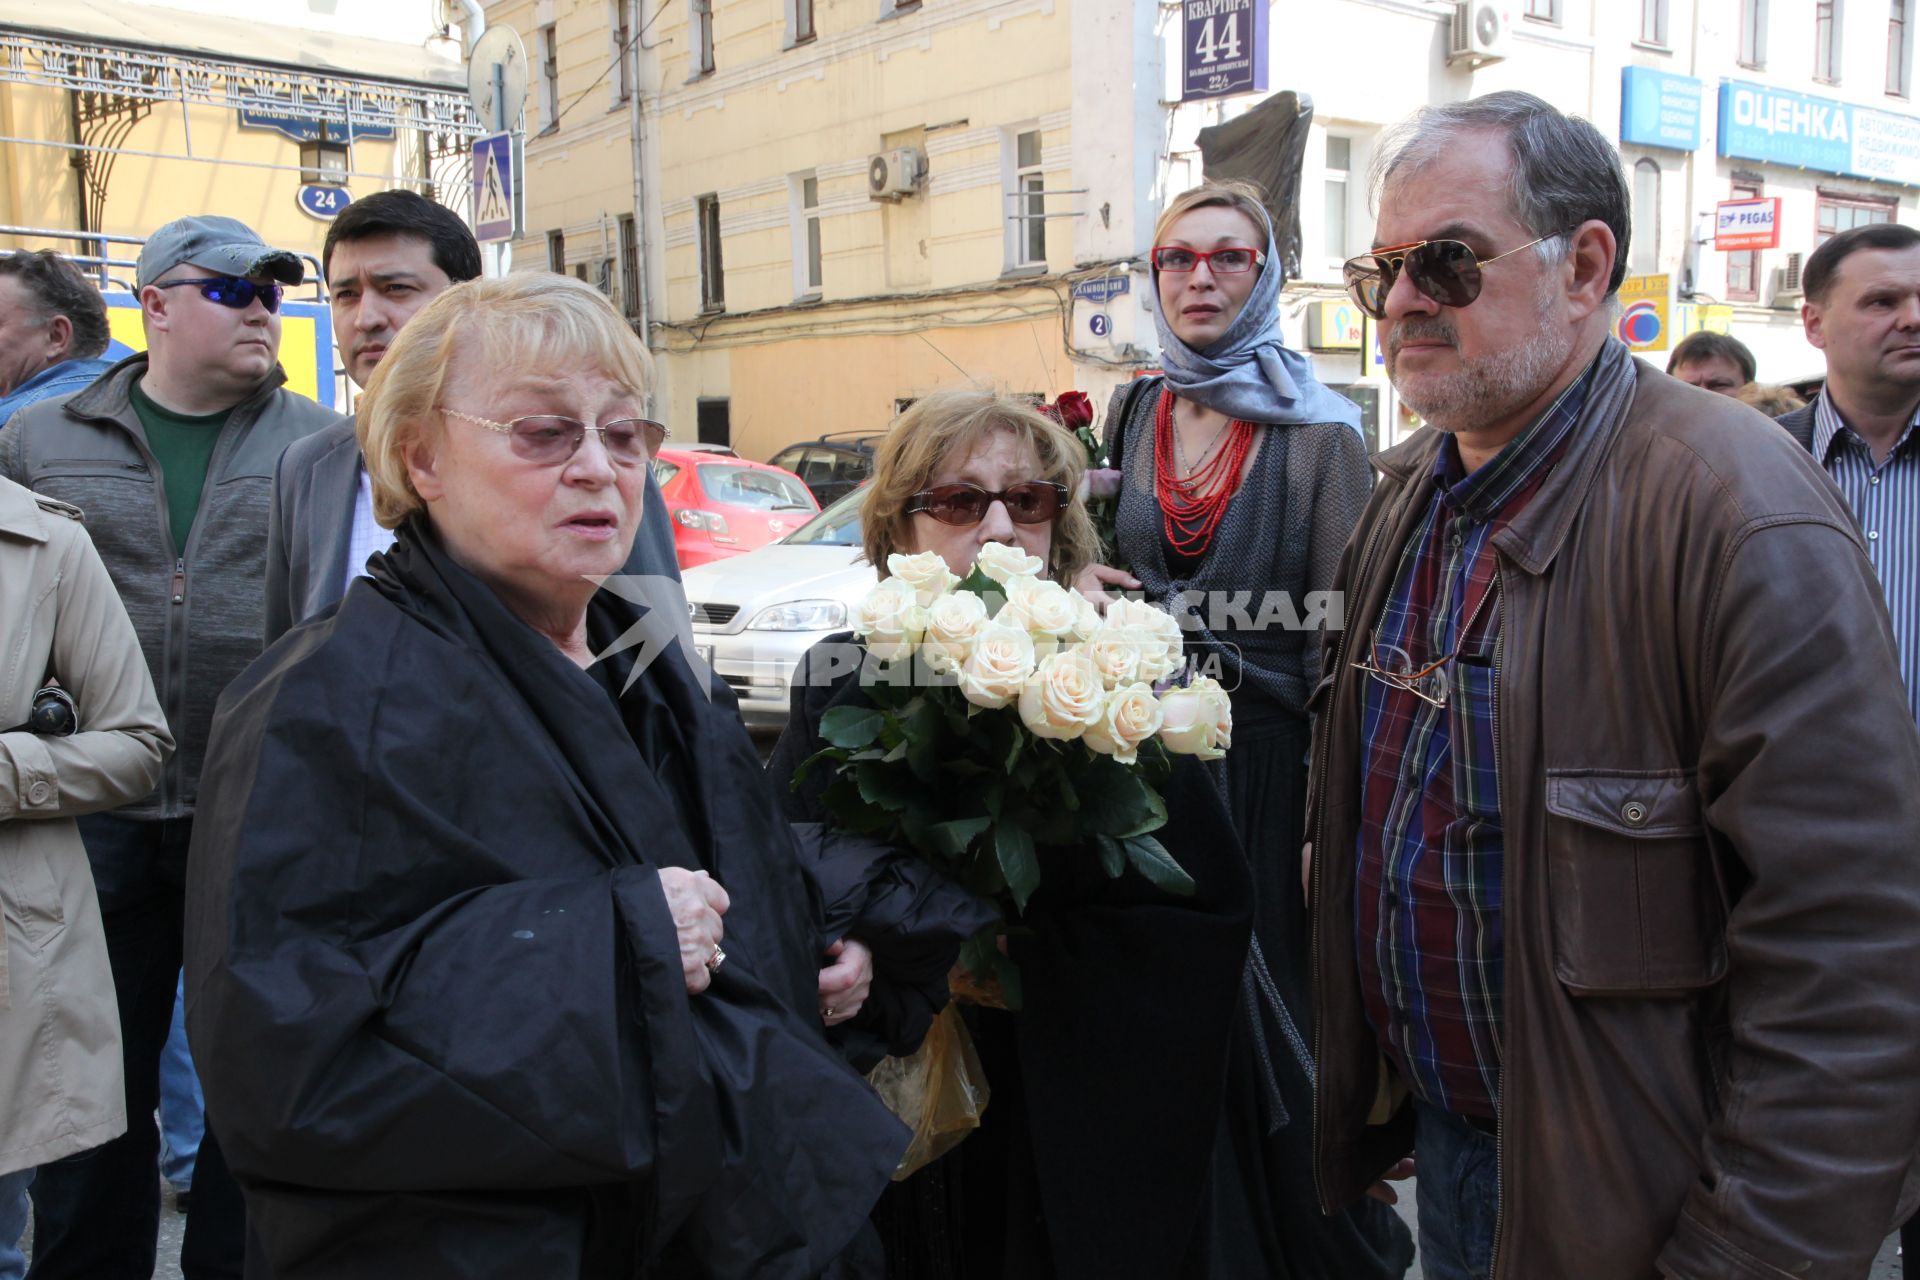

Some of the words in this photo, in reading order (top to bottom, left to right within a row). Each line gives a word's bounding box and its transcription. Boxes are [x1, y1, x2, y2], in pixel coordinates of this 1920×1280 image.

[1188, 0, 1249, 20] КВАРТИРА
[1195, 13, 1241, 64] 44
[1734, 89, 1849, 144] ОЦЕНКА
[315, 190, 336, 208] 24
[1739, 211, 1773, 225] PEGAS
[1095, 317, 1103, 333] 2
